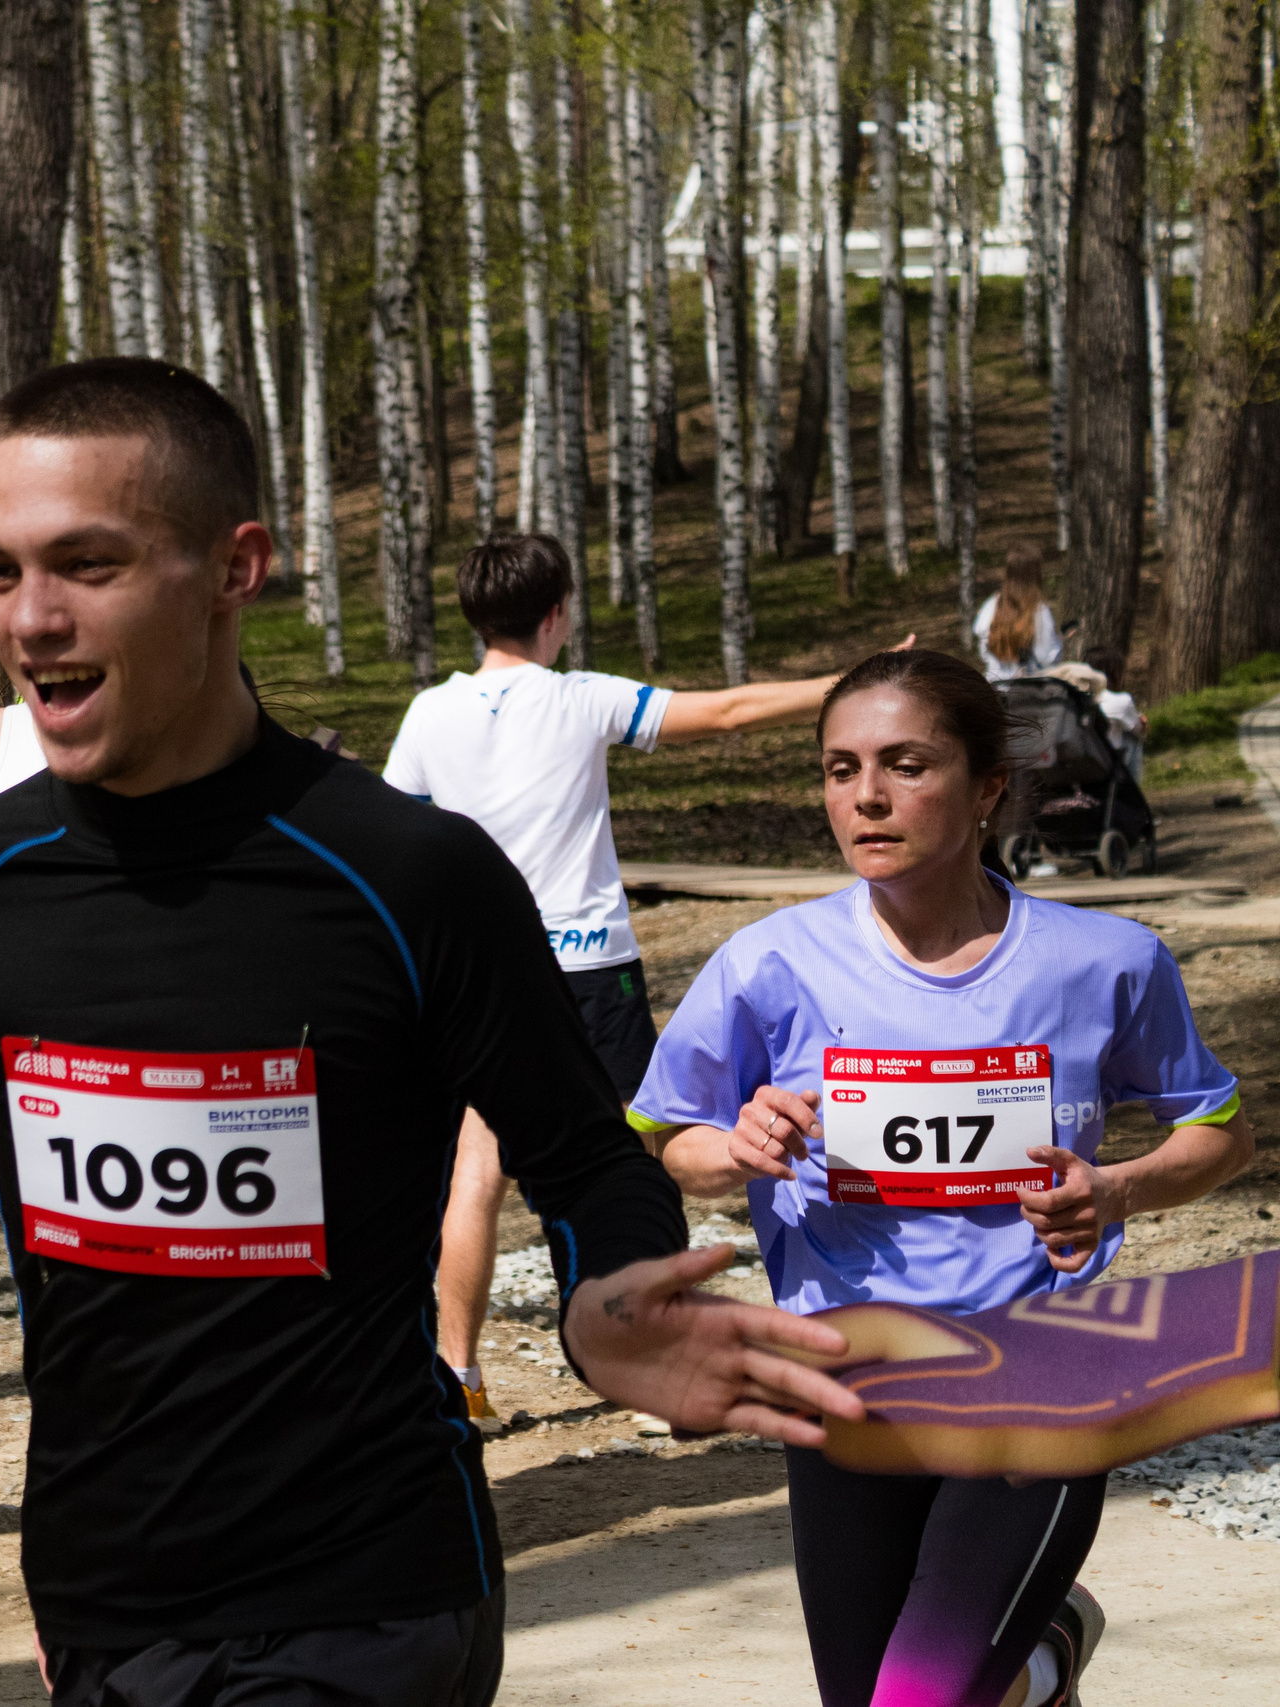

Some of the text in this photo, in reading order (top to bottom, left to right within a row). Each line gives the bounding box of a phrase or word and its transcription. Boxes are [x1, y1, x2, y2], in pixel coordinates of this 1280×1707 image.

[546, 927, 609, 952] EAM
[70, 1058, 130, 1075] МАЙСКАЯ
[876, 1057, 922, 1067] МАЙСКАЯ
[935, 1062, 971, 1071] MAKFA
[149, 1072, 198, 1083] MAKFA
[876, 1067, 907, 1076] ГРОЗА
[71, 1072, 110, 1085] ГРОЗА
[836, 1091, 847, 1100] 10
[977, 1085, 1045, 1097] ВИКТОРИЯ
[24, 1098, 37, 1111] 10
[208, 1106, 309, 1122] ВИКТОРИЯ
[883, 1115, 995, 1165] 617
[47, 1136, 276, 1217] 1096
[837, 1183, 877, 1193] SWEEDOM
[946, 1184, 986, 1195] BRIGHT
[34, 1226, 79, 1248] SWEEDOM
[168, 1244, 227, 1260] BRIGHT
[239, 1242, 312, 1260] BERGAUER
